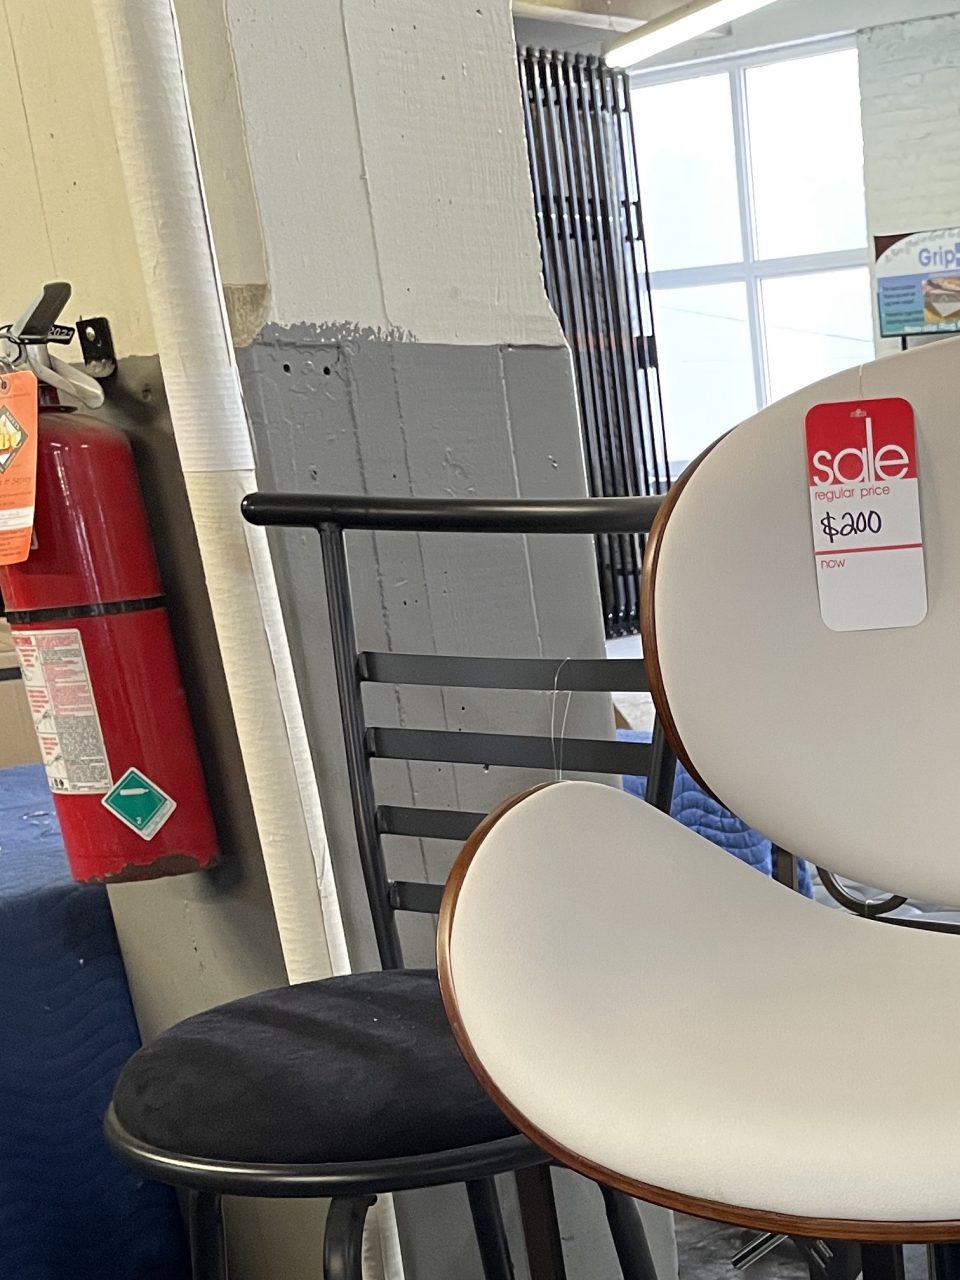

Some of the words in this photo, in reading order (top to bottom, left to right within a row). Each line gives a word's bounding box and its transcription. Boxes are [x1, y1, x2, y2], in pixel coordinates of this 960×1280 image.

[812, 417, 910, 486] sale
[815, 485, 855, 503] regular
[860, 484, 890, 499] price
[820, 510, 882, 543] $200
[820, 558, 846, 569] now
